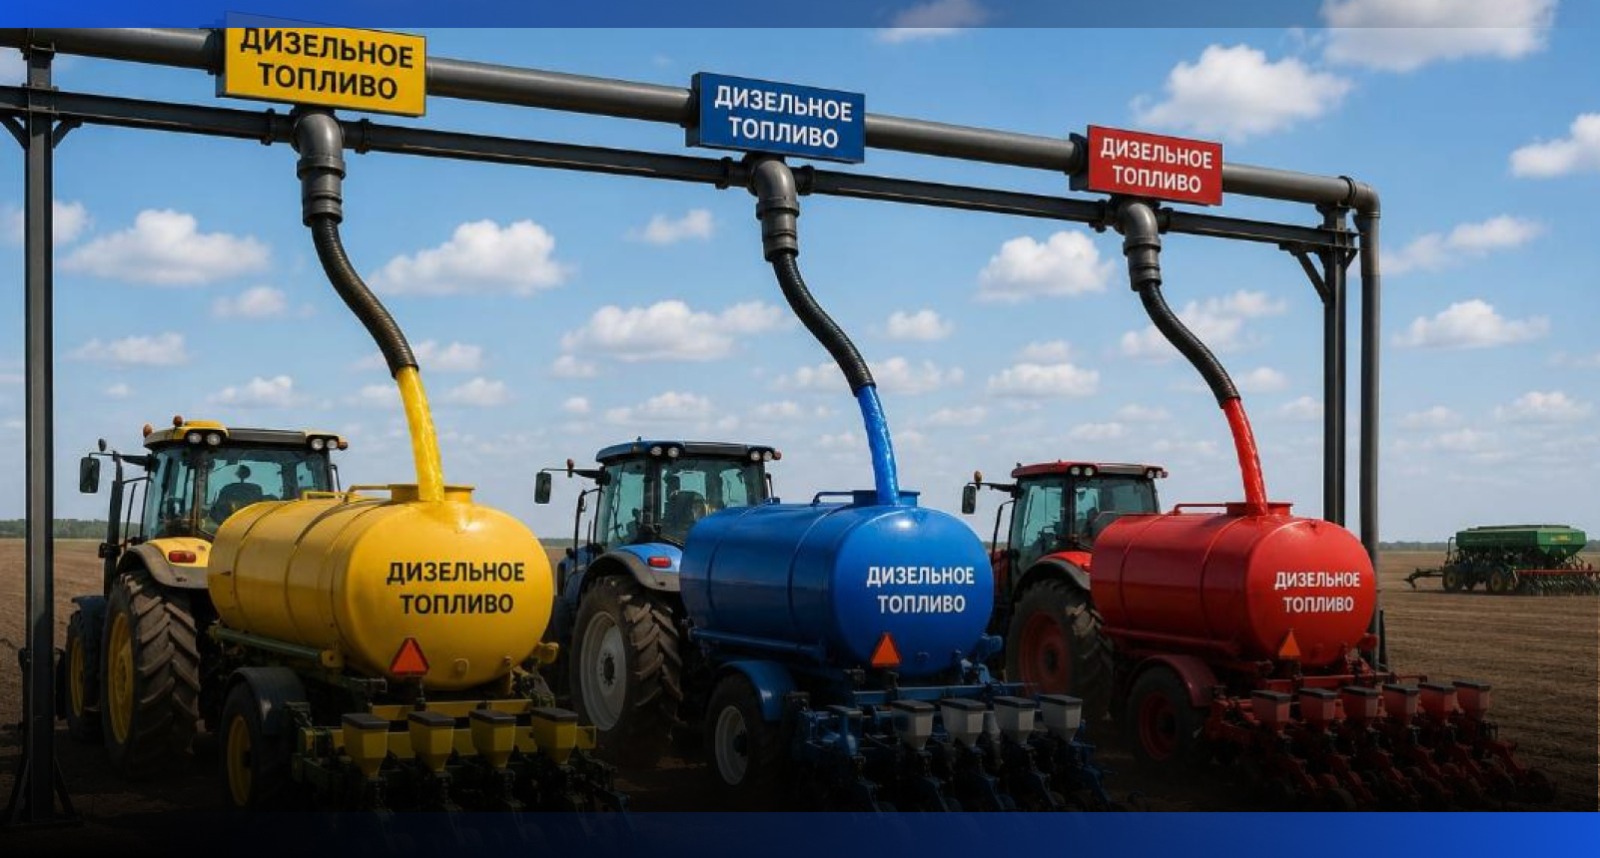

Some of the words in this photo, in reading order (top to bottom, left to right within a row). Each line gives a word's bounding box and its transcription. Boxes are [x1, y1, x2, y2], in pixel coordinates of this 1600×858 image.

[240, 27, 413, 69] ДИЗЕЛЬНОЕ
[257, 62, 398, 100] ТОПЛИВО
[714, 85, 853, 122] ДИЗЕЛЬНОЕ
[728, 116, 839, 149] ТОПЛИВО
[1100, 137, 1213, 170] ДИЗЕЛЬНОЕ
[1112, 165, 1202, 193] ТОПЛИВО
[386, 562, 525, 585] ДИЗЕЛЬНОЕ
[866, 566, 975, 588] ДИЗЕЛЬНОЕ
[1274, 571, 1360, 590] ДИЗЕЛЬНОЕ
[399, 594, 514, 614] ТОПЛИВО
[877, 595, 966, 614] ТОПЛИВО
[1283, 596, 1354, 613] ТОПЛИВО
